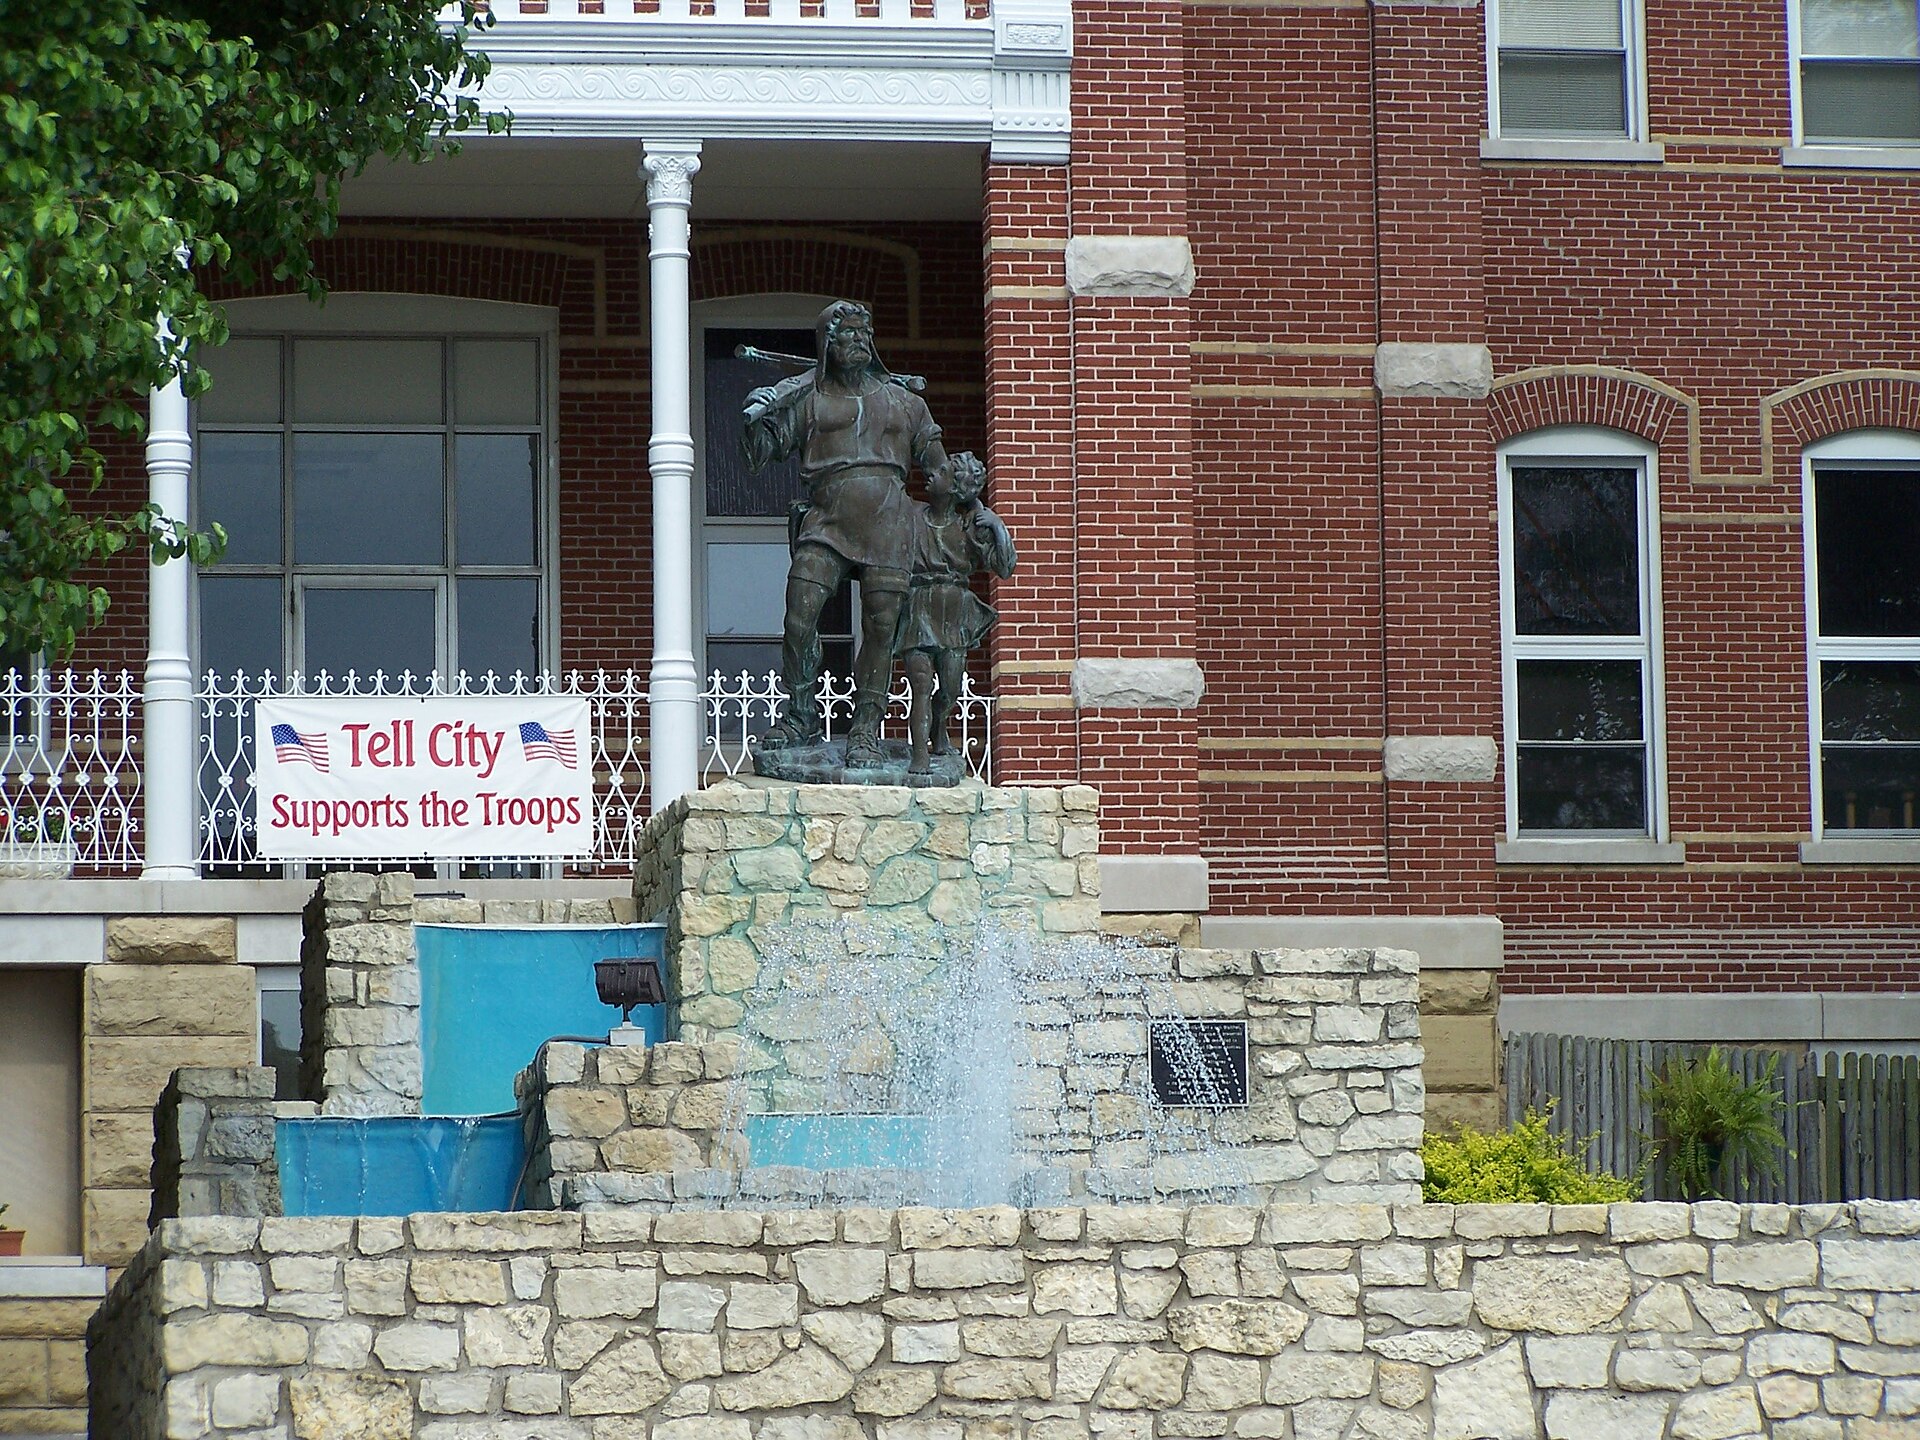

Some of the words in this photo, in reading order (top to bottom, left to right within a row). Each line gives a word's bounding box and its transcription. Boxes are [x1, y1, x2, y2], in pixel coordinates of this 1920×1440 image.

[341, 720, 415, 768] Tell
[428, 720, 505, 779] City
[271, 794, 409, 836] Supports
[418, 791, 469, 828] the
[475, 792, 581, 833] Troops
